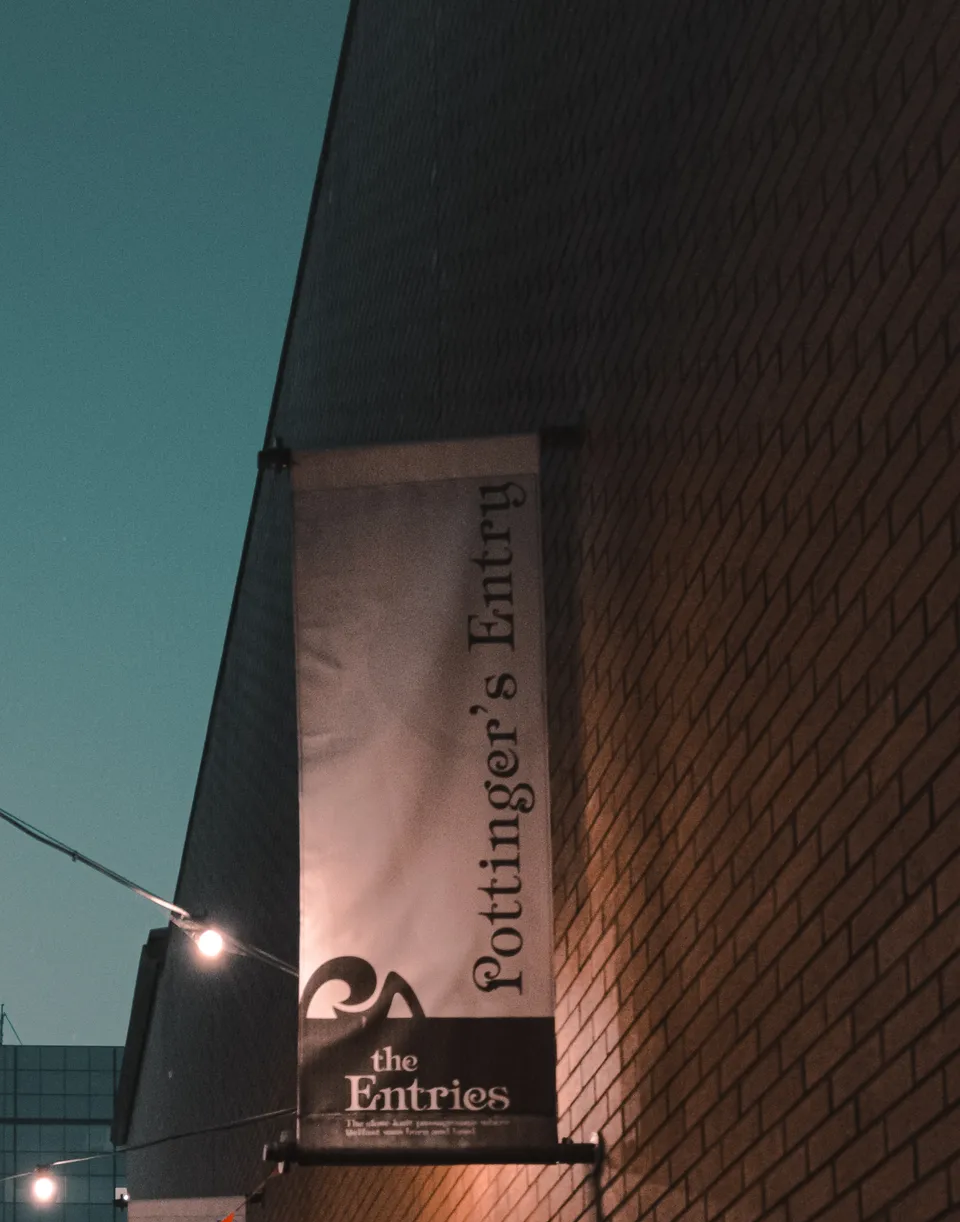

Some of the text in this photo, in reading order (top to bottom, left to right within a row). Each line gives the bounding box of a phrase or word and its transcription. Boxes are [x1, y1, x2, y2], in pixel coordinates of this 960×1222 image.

[468, 479, 536, 996] Pottinger's Entry
[370, 1046, 418, 1072] the
[344, 1075, 511, 1112] Entries
